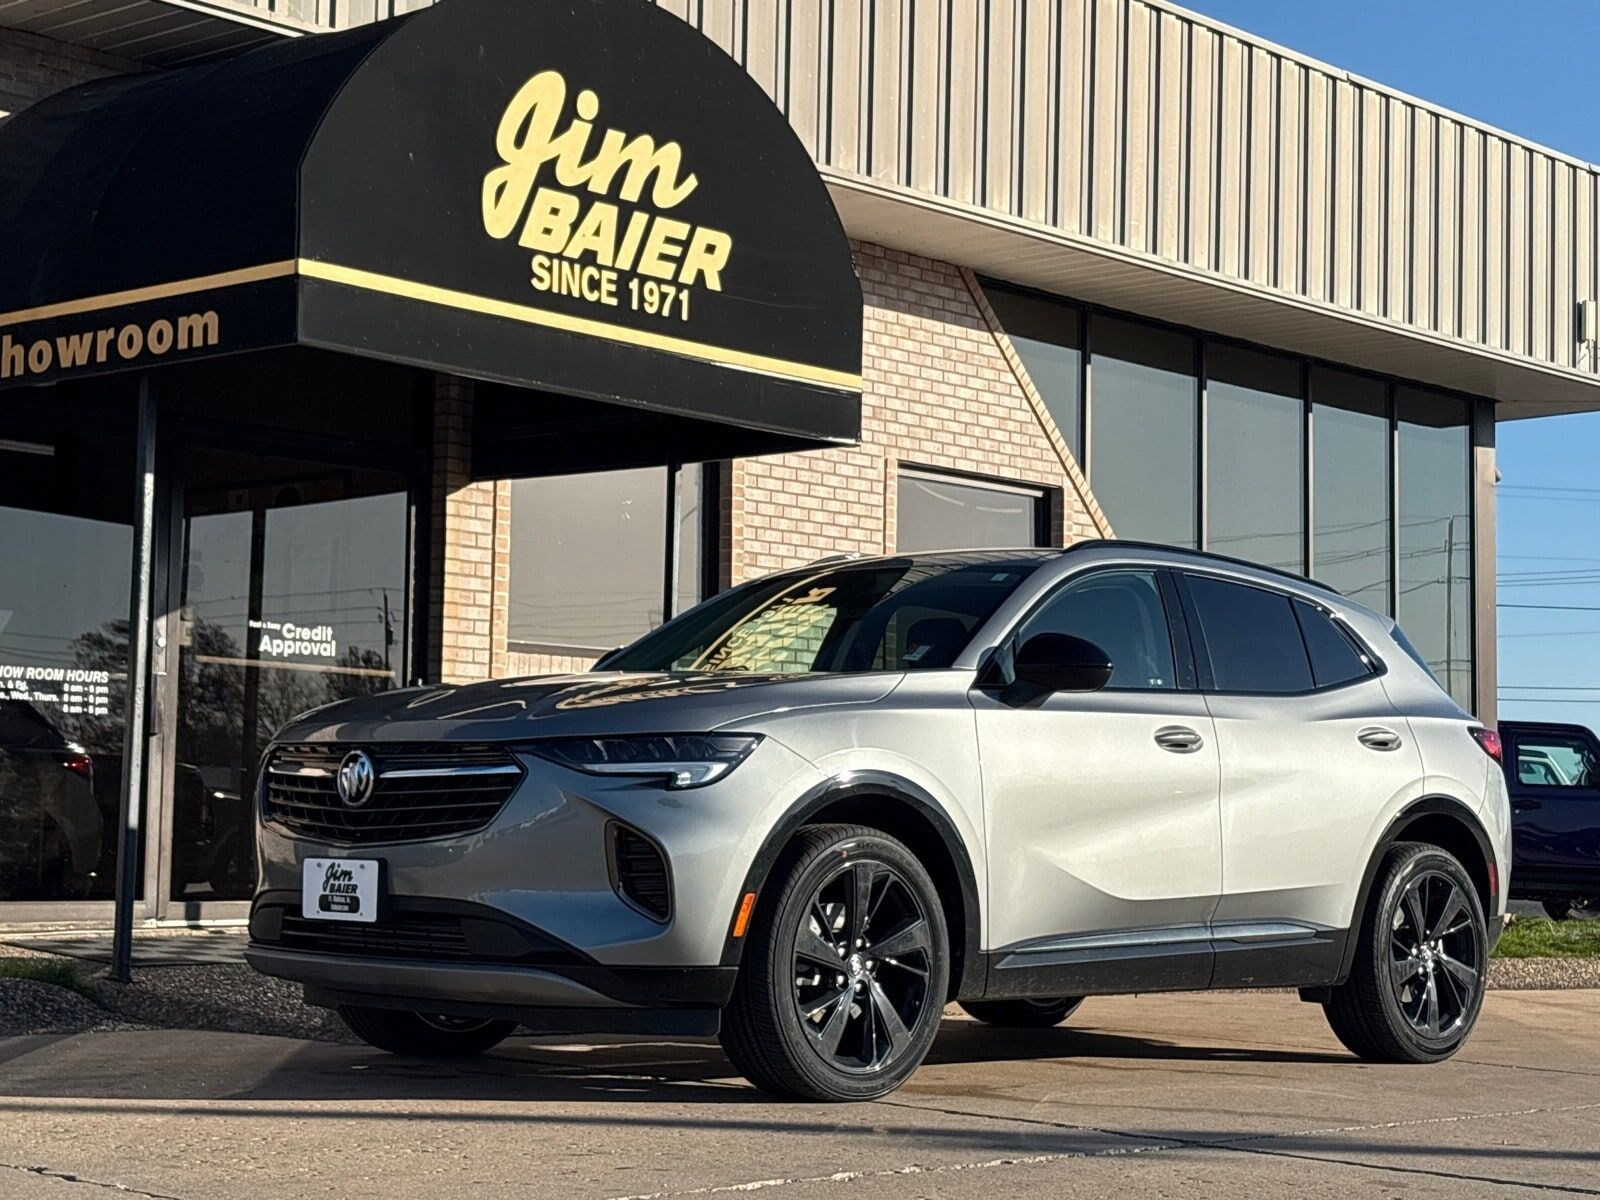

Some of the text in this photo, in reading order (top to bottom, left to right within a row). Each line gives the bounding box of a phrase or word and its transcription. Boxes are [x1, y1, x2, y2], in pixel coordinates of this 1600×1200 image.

[483, 70, 698, 239] Jim
[518, 187, 732, 291] BAIER
[531, 255, 689, 320] SINCE 1971
[0, 310, 219, 378] howroom
[282, 622, 333, 642] Credit
[259, 634, 336, 657] Approval
[26, 667, 64, 681] ROOM
[66, 669, 109, 683] HOURS
[70, 684, 83, 692] am
[95, 686, 109, 695] pm
[70, 694, 83, 702] am
[95, 696, 108, 706] pm
[69, 705, 82, 713] am
[94, 707, 108, 717] pm
[322, 862, 353, 892] Jim
[329, 883, 358, 894] BAIER
